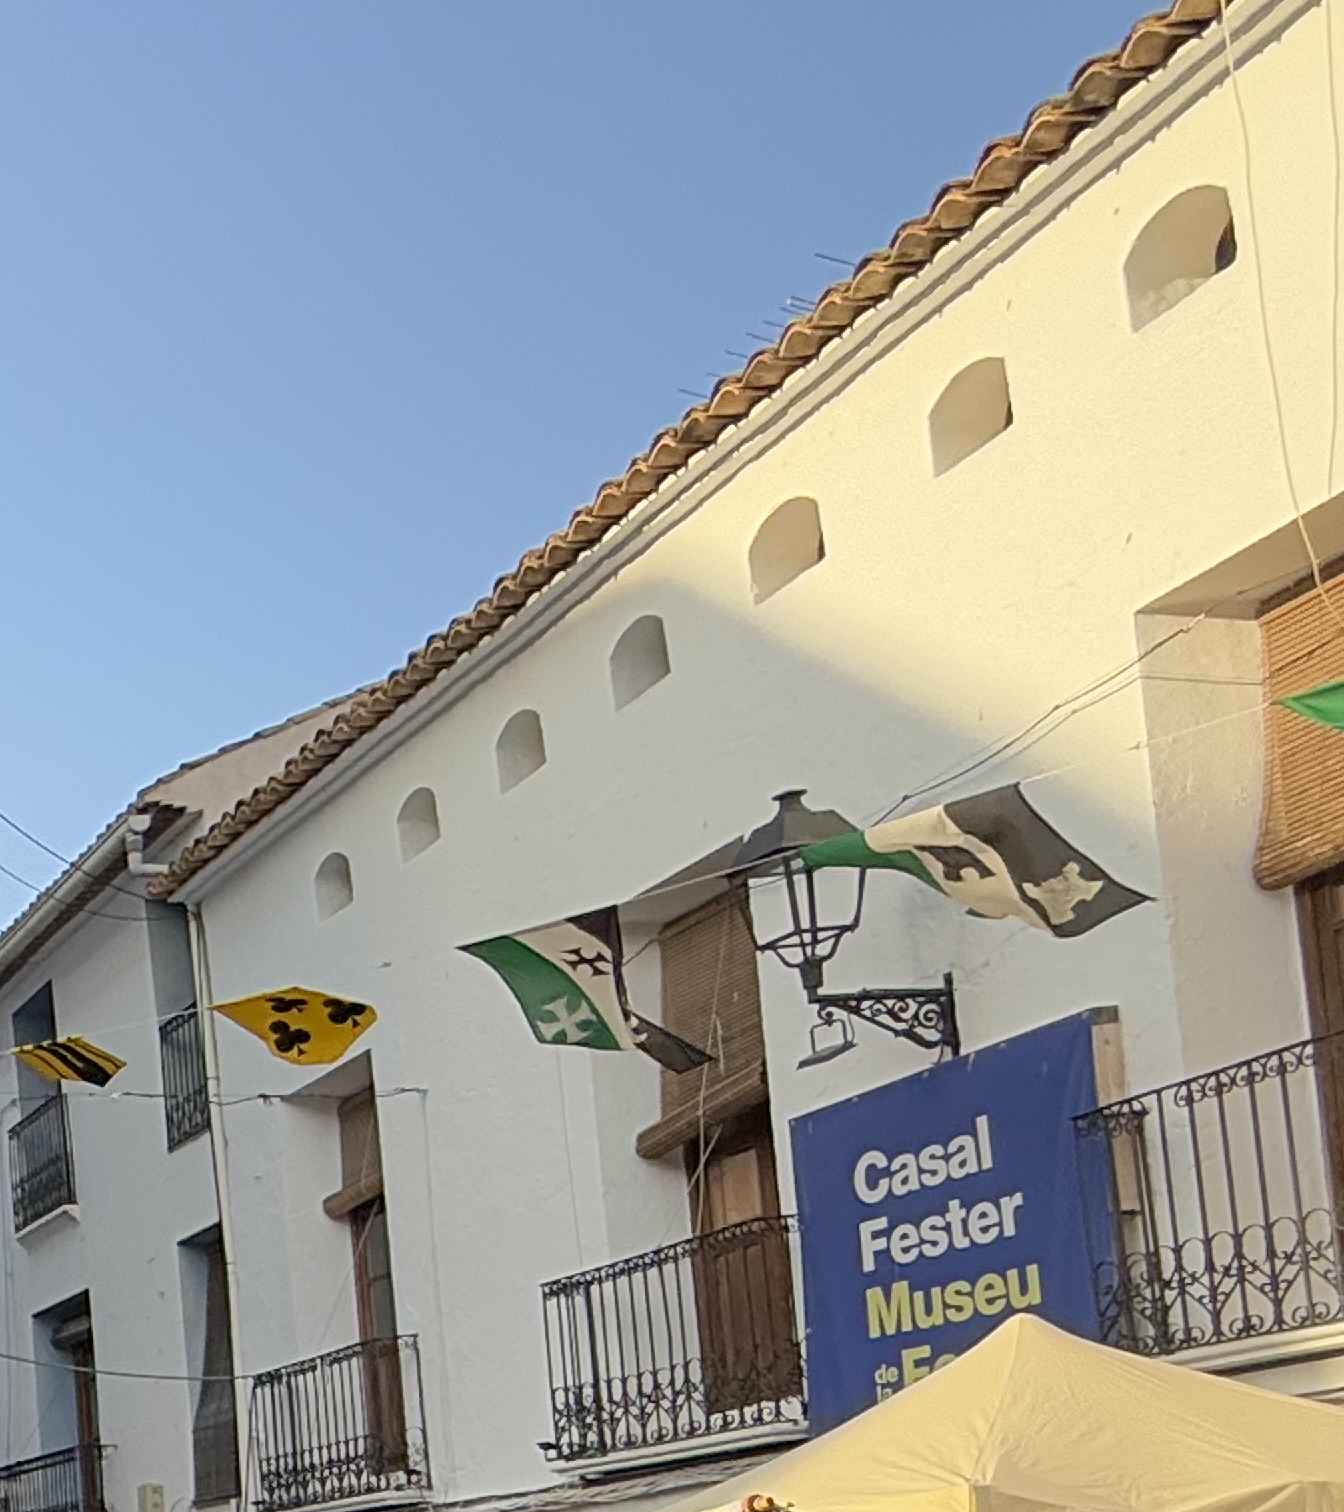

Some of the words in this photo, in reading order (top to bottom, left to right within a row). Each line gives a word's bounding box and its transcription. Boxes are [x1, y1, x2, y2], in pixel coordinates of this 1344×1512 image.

[854, 1115, 993, 1204] Casal
[859, 1193, 1024, 1273] Fester
[865, 1263, 1042, 1339] Museu
[874, 1364, 899, 1383] de
